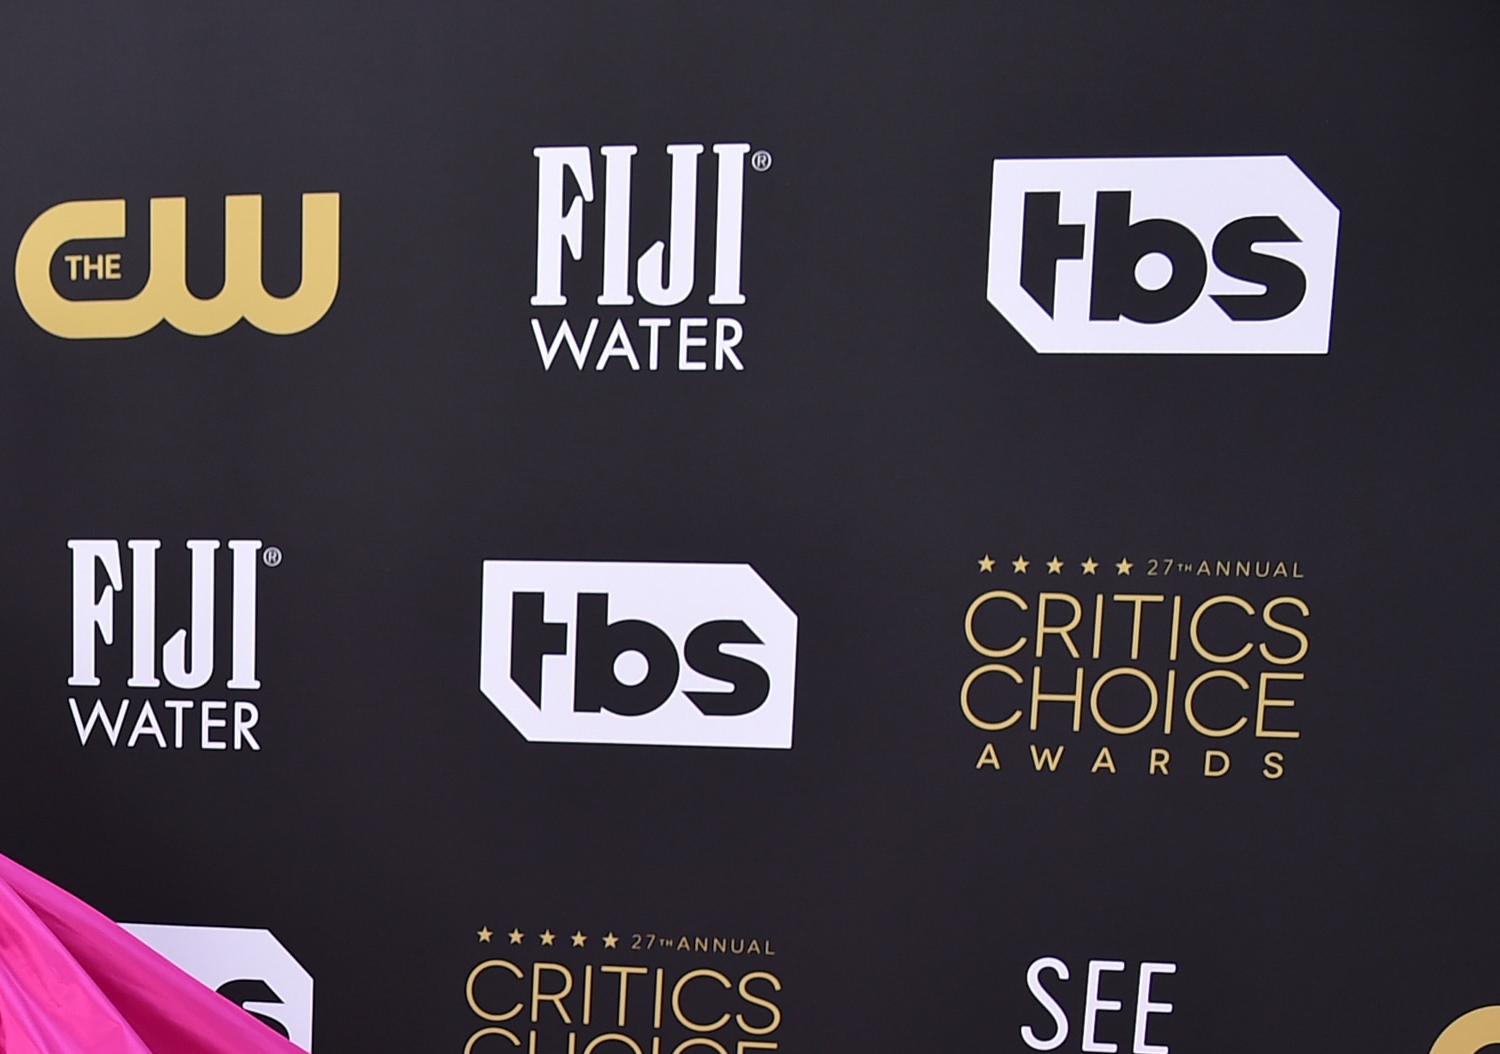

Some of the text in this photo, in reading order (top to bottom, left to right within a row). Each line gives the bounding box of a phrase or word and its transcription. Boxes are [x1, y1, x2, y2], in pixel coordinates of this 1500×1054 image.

[15, 193, 339, 338] CW
[65, 254, 121, 280] THE
[1020, 191, 1306, 324] tbs
[531, 318, 743, 370] WATER
[1195, 558, 1306, 580] ANNUAL
[510, 592, 770, 716] tbs
[965, 591, 1309, 664] CRITICS
[69, 698, 260, 750] WATER
[961, 664, 1304, 737] CHOICE
[976, 744, 1283, 778] AWARDS
[676, 934, 776, 957] ANNUAL
[466, 960, 781, 1034] CRITICS
[1021, 958, 1176, 1054] SEE
